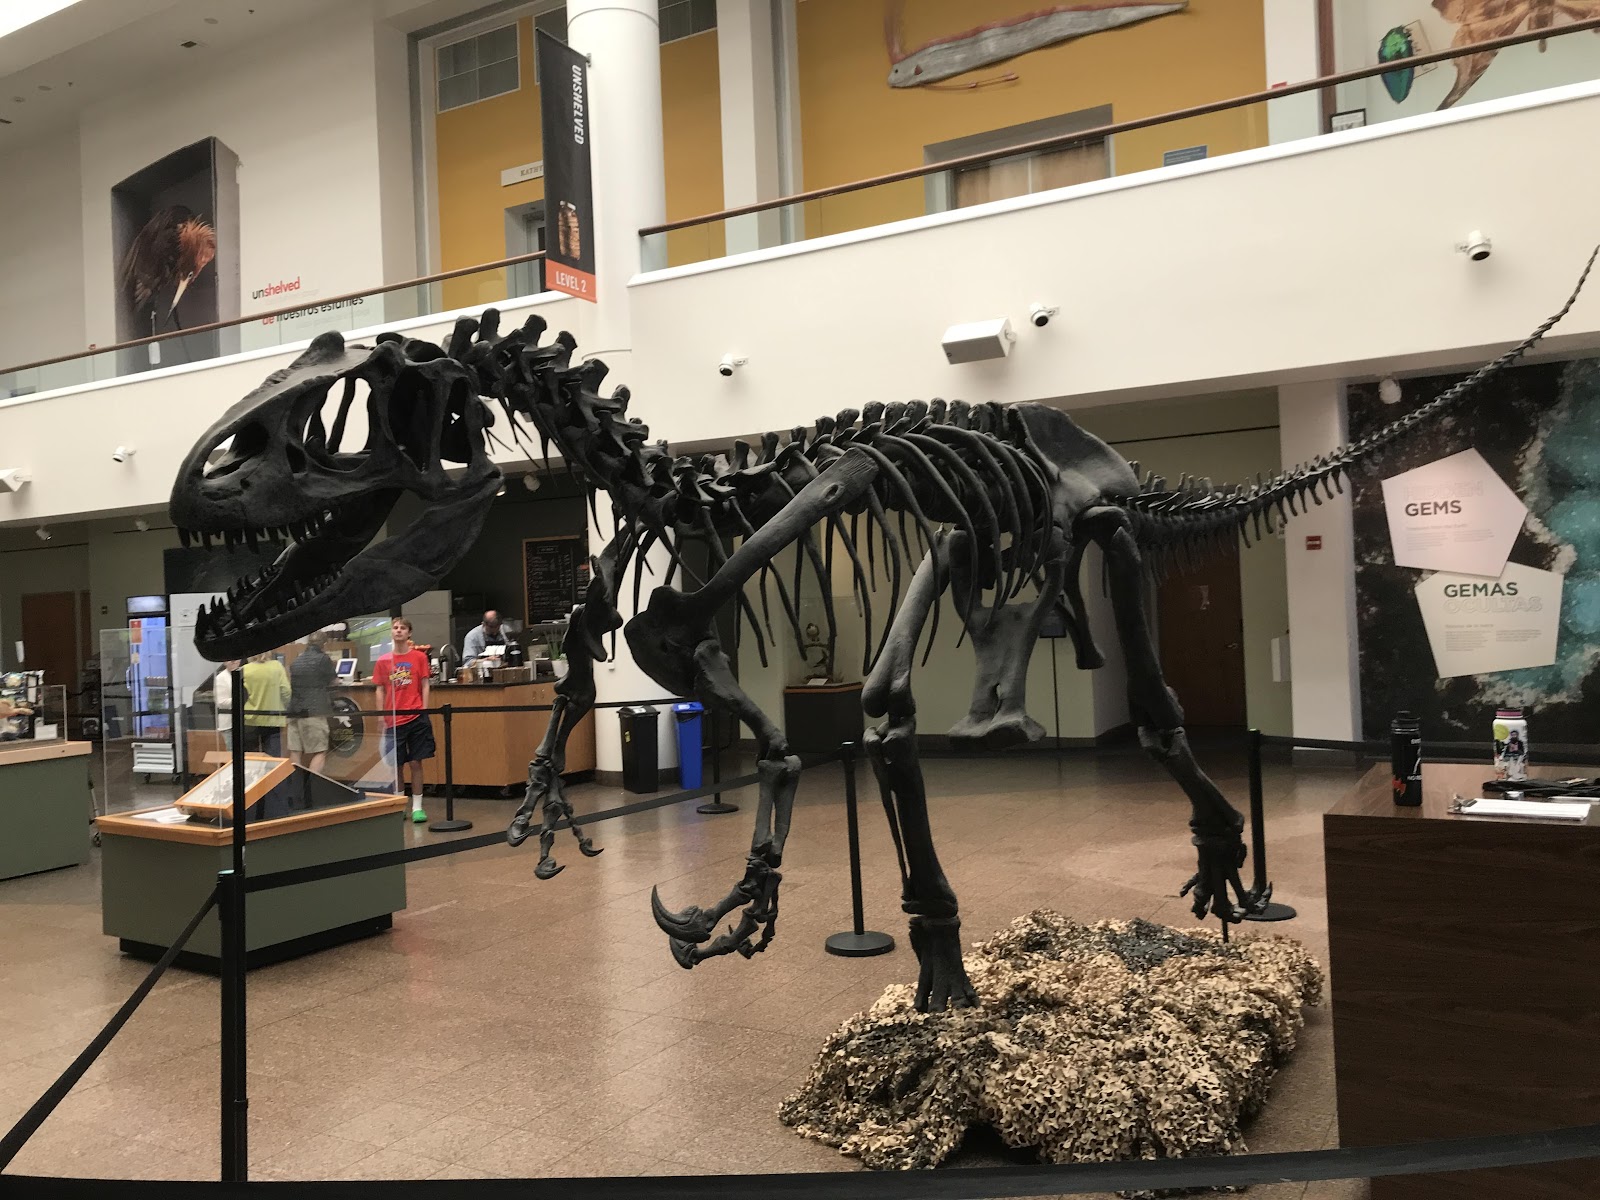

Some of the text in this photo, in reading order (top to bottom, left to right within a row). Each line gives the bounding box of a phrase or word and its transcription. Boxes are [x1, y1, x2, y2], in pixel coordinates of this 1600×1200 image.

[572, 64, 584, 145] UNSHELVED
[252, 276, 300, 299] unshelved
[555, 271, 587, 293] LEVEL 2
[1405, 499, 1462, 517] GEMS
[1443, 582, 1519, 598] GEMAS
[1443, 596, 1543, 614] OCULTAS
